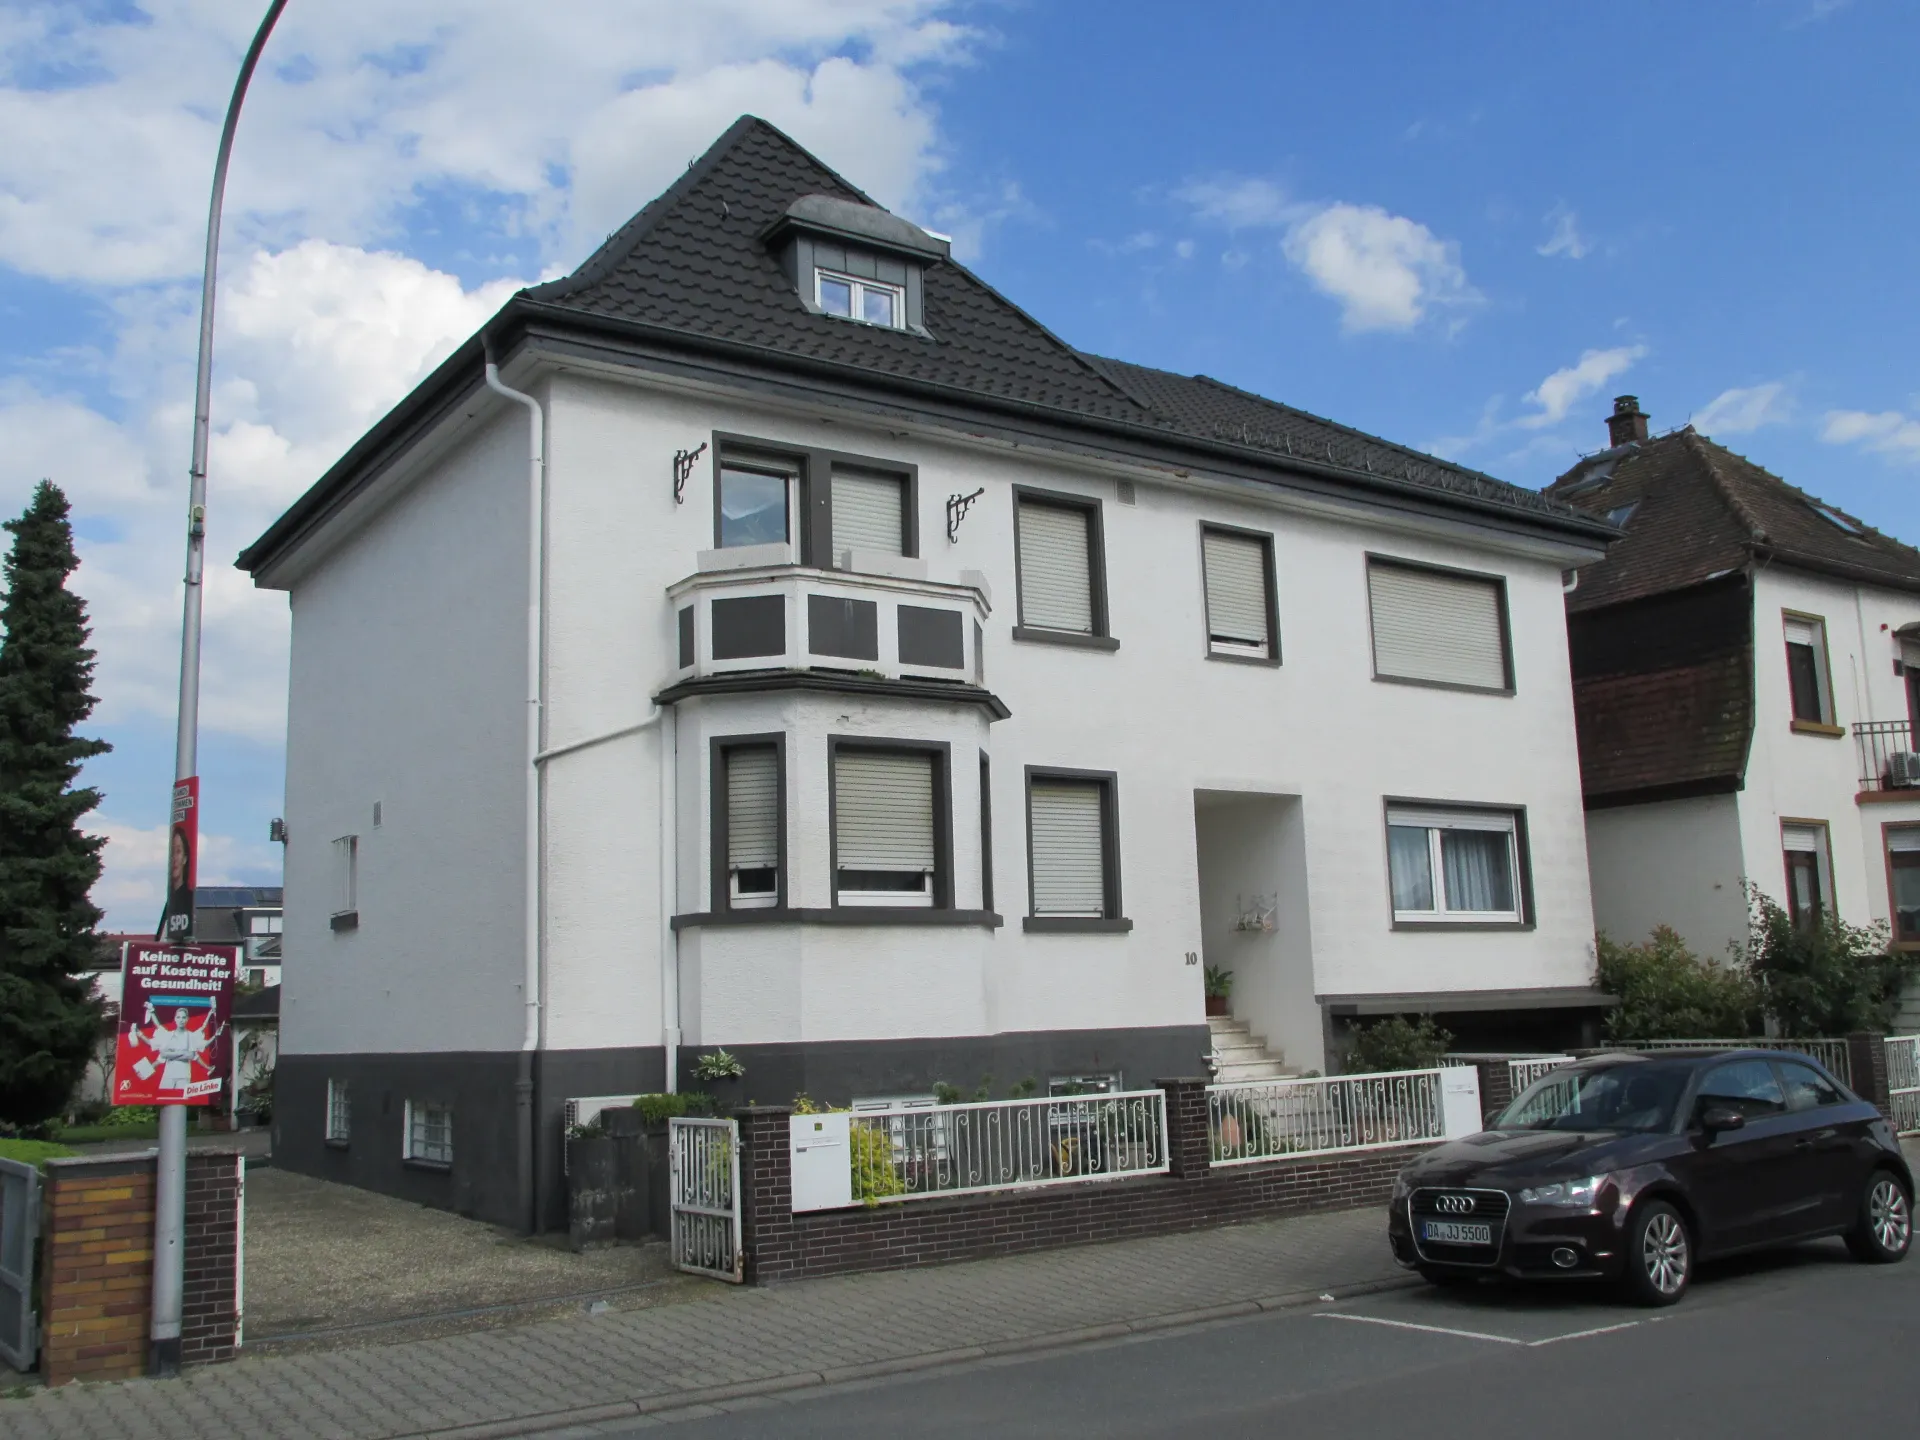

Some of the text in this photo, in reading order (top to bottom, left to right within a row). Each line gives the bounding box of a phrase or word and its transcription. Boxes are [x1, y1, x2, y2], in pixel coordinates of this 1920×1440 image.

[169, 913, 189, 932] SPD
[139, 950, 227, 966] Keine Profite
[1185, 952, 1197, 965] 10
[132, 964, 231, 979] auf Kosten der
[141, 978, 222, 991] Gesundheit!
[186, 1082, 219, 1095] Die Linke
[1428, 1224, 1488, 1241] DA JJ 5500
